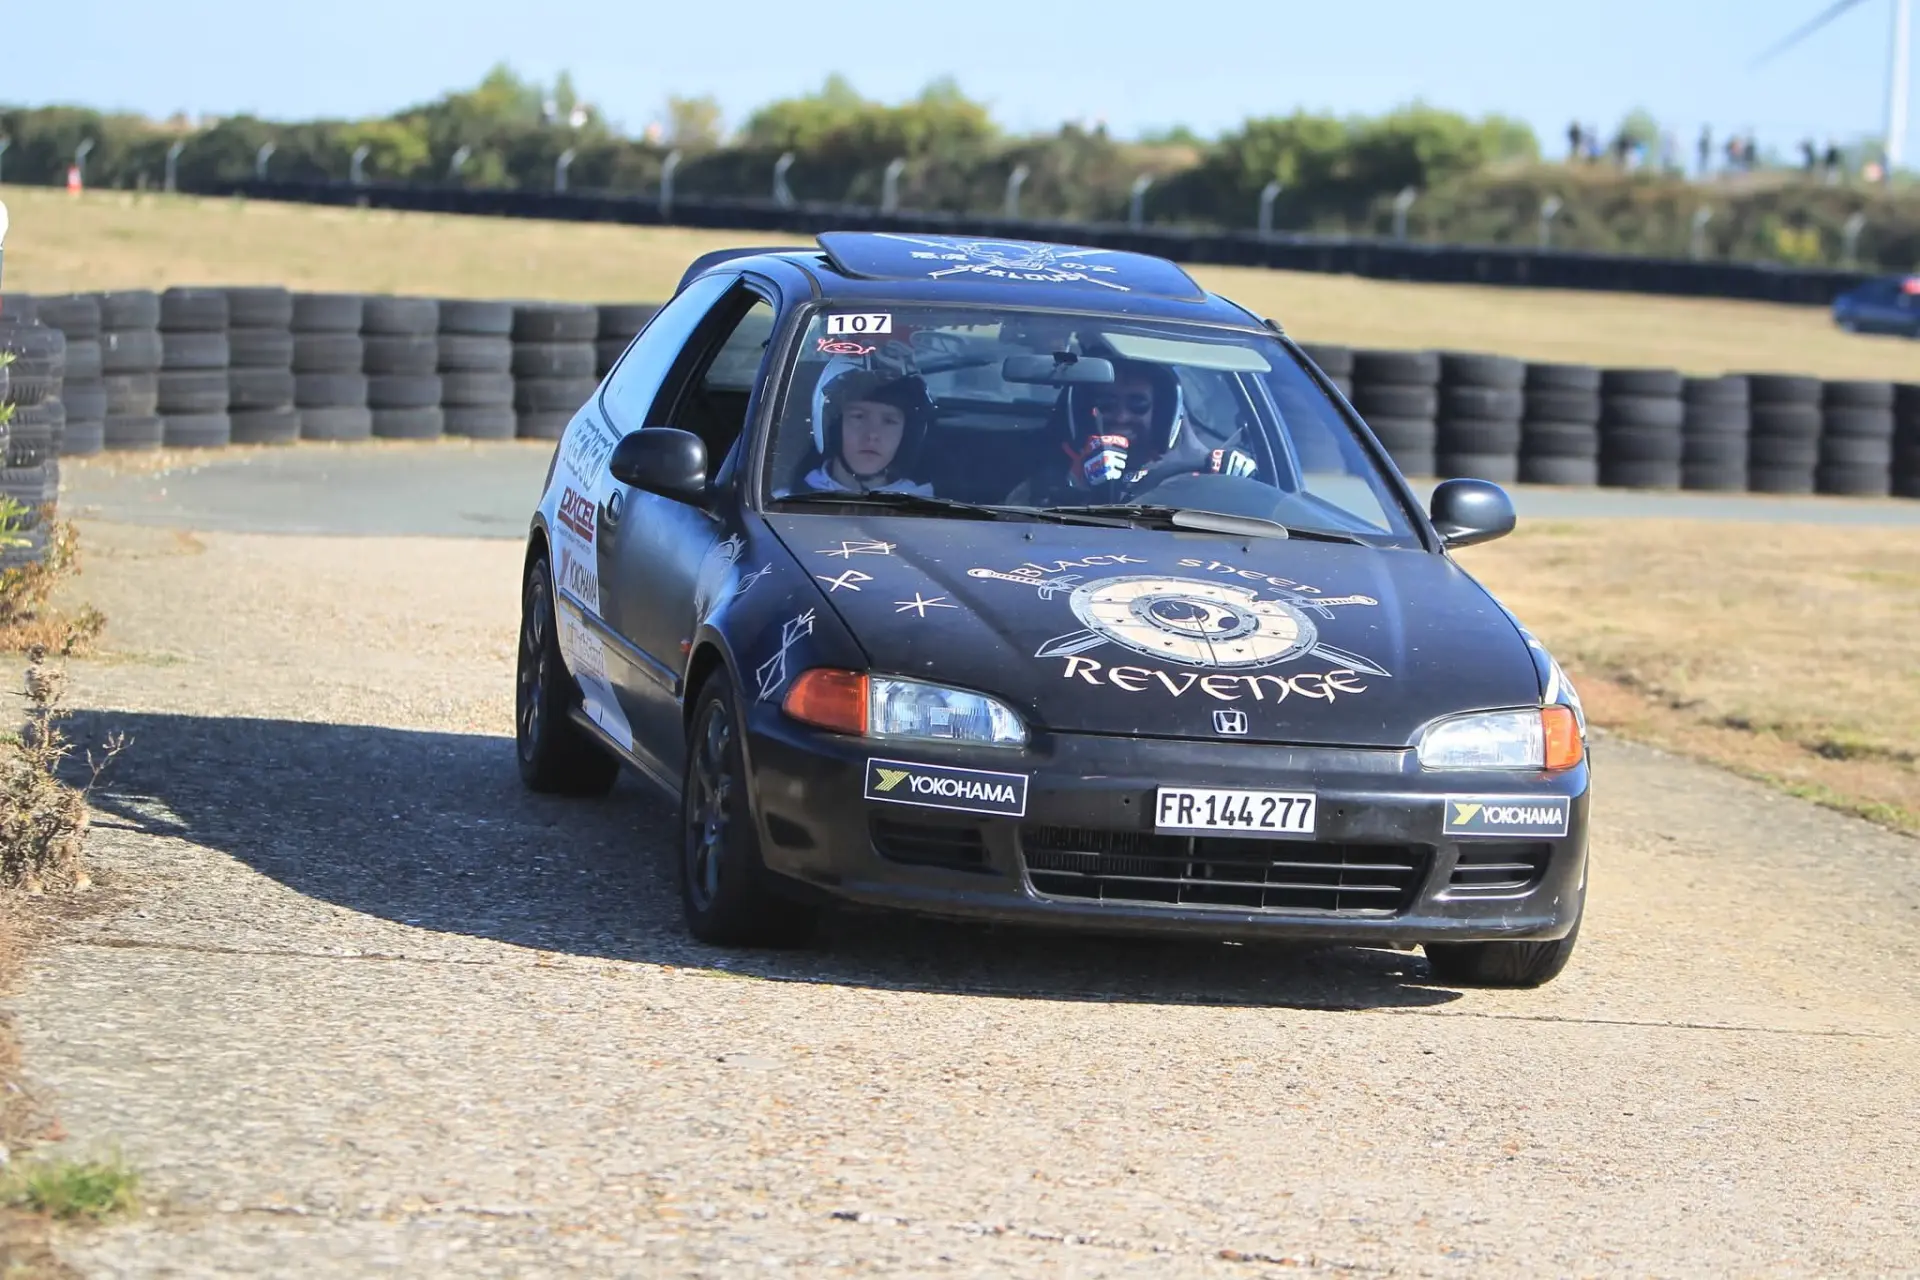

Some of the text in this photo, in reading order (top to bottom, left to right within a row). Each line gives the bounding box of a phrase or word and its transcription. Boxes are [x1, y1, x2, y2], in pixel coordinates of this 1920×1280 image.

[835, 315, 887, 332] 107
[560, 486, 595, 531] DIXCEL
[1009, 554, 1323, 594] BLACK SHEEP
[1063, 655, 1368, 705] REVENGE
[908, 774, 1016, 804] YOKOHAMA
[1481, 806, 1563, 825] YOKOHAMA
